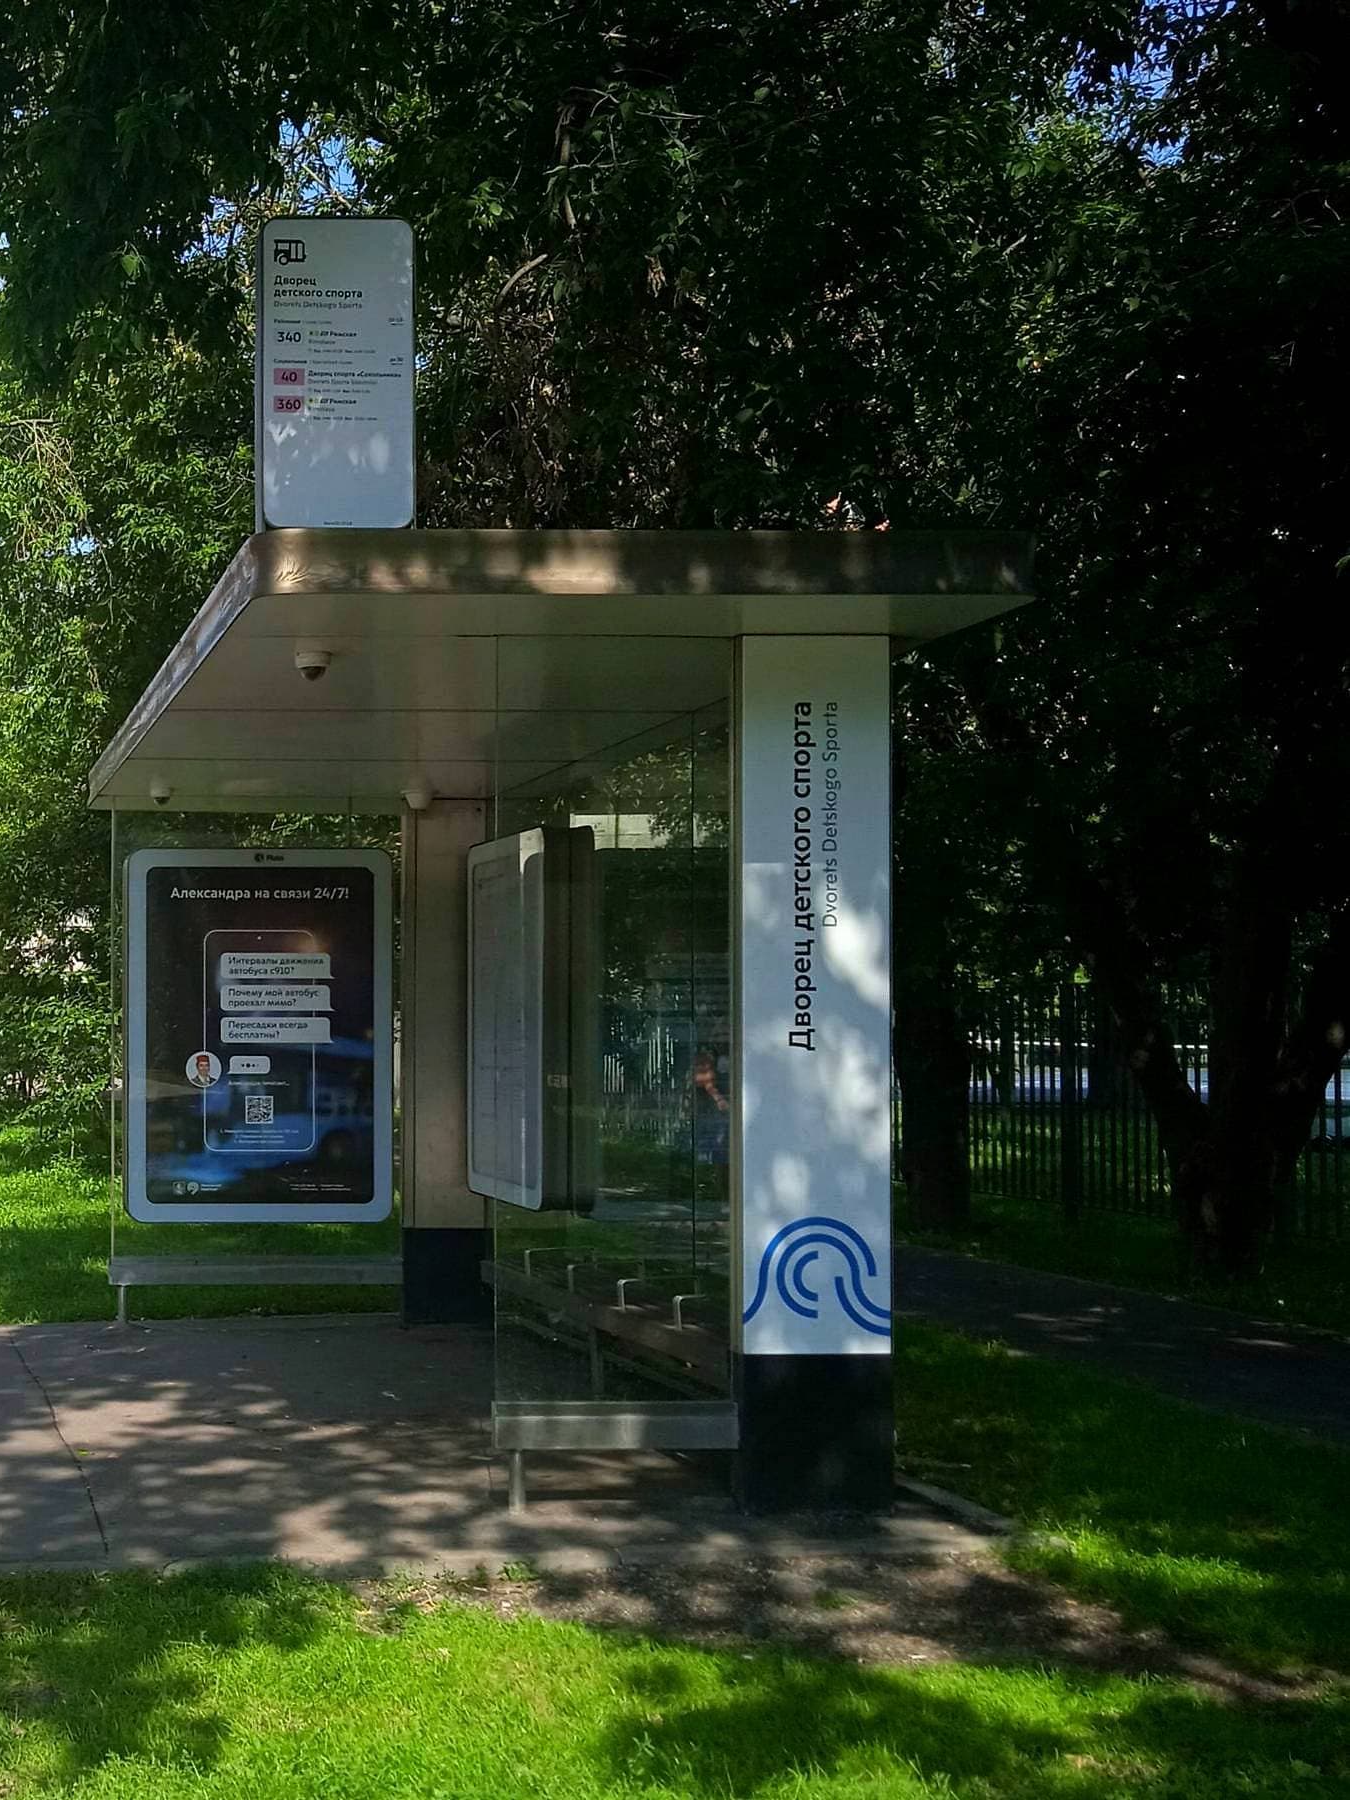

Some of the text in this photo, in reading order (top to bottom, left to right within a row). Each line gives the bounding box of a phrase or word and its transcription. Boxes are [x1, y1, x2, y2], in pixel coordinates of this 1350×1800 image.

[273, 275, 317, 287] Дворец
[273, 289, 363, 299] детского спорта
[277, 331, 302, 343] 340
[281, 371, 298, 383] 40
[277, 399, 302, 411] 360
[821, 701, 842, 928] Dvorets Detskogo Sporta
[788, 701, 818, 1051] Дворец детского спорта
[170, 887, 350, 901] Александра на связи 24/7!
[228, 956, 324, 967] Интервалы движения
[228, 966, 268, 976] автобуса
[228, 988, 319, 999] Почему мой автобус
[228, 998, 297, 1008] проехал мимо?
[228, 1021, 308, 1031] Пересадки всегда
[228, 1030, 280, 1039] бесплатны?
